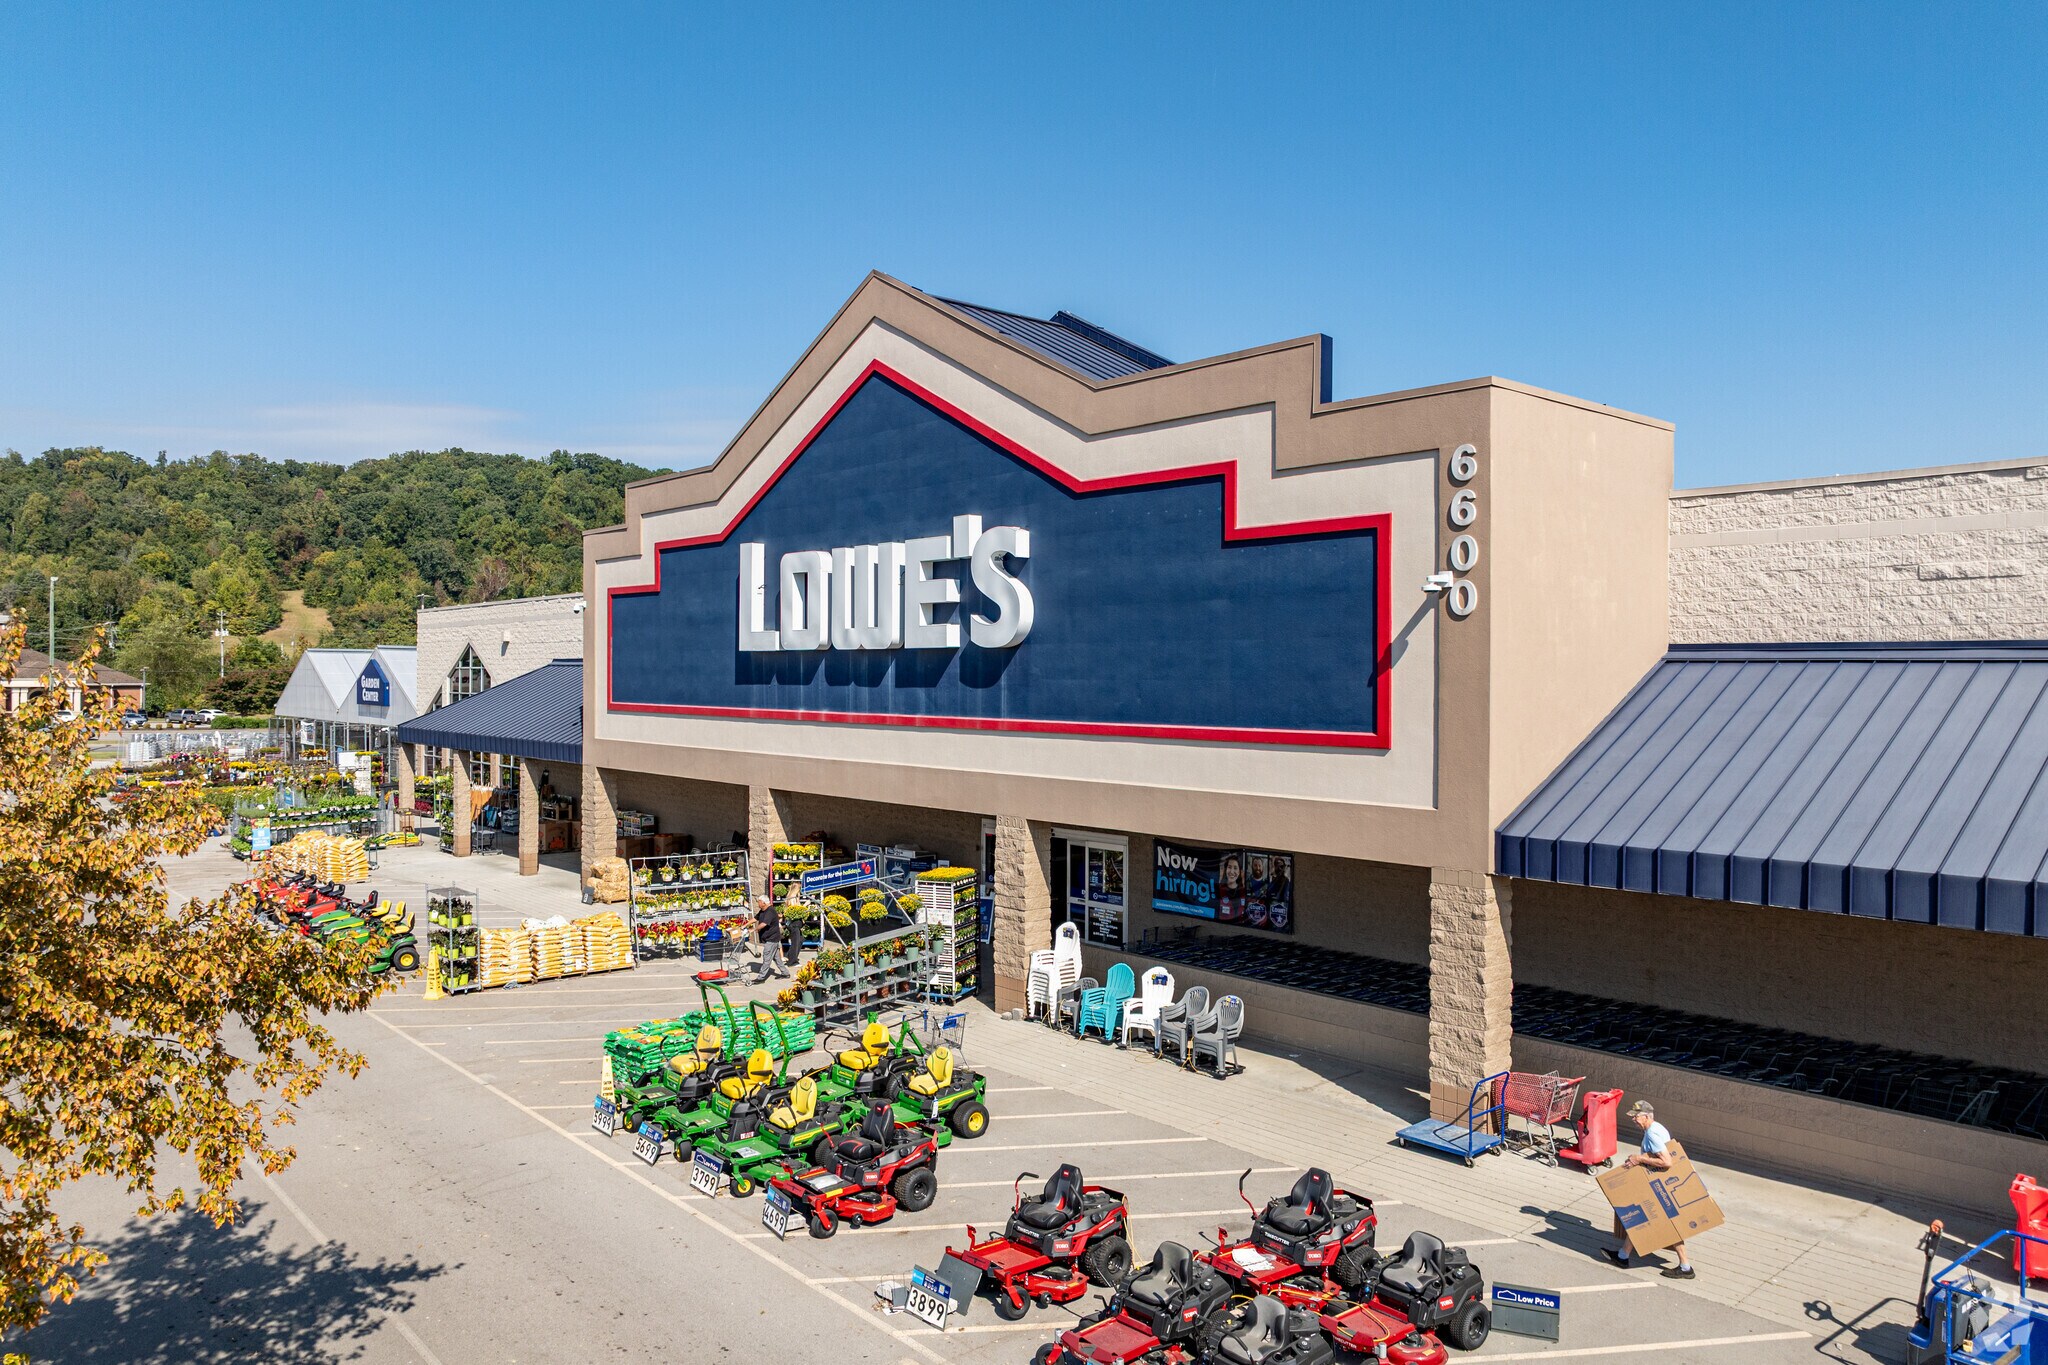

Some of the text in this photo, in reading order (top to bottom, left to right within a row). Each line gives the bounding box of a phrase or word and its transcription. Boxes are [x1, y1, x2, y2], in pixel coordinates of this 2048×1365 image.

[1450, 443, 1478, 616] 6600
[739, 514, 1034, 651] LOWE'S
[1157, 846, 1198, 872] Now
[806, 873, 828, 883] Decorate
[1156, 869, 1216, 903] hiring!
[594, 1111, 612, 1130] 5999
[636, 1138, 657, 1159] 5699
[693, 1167, 716, 1191] 3799
[1654, 1182, 1671, 1207] medium
[764, 1204, 785, 1231] 4699
[910, 1289, 945, 1321] 3899
[1440, 1299, 1454, 1307] TORO
[1517, 1294, 1555, 1308] Low Price
